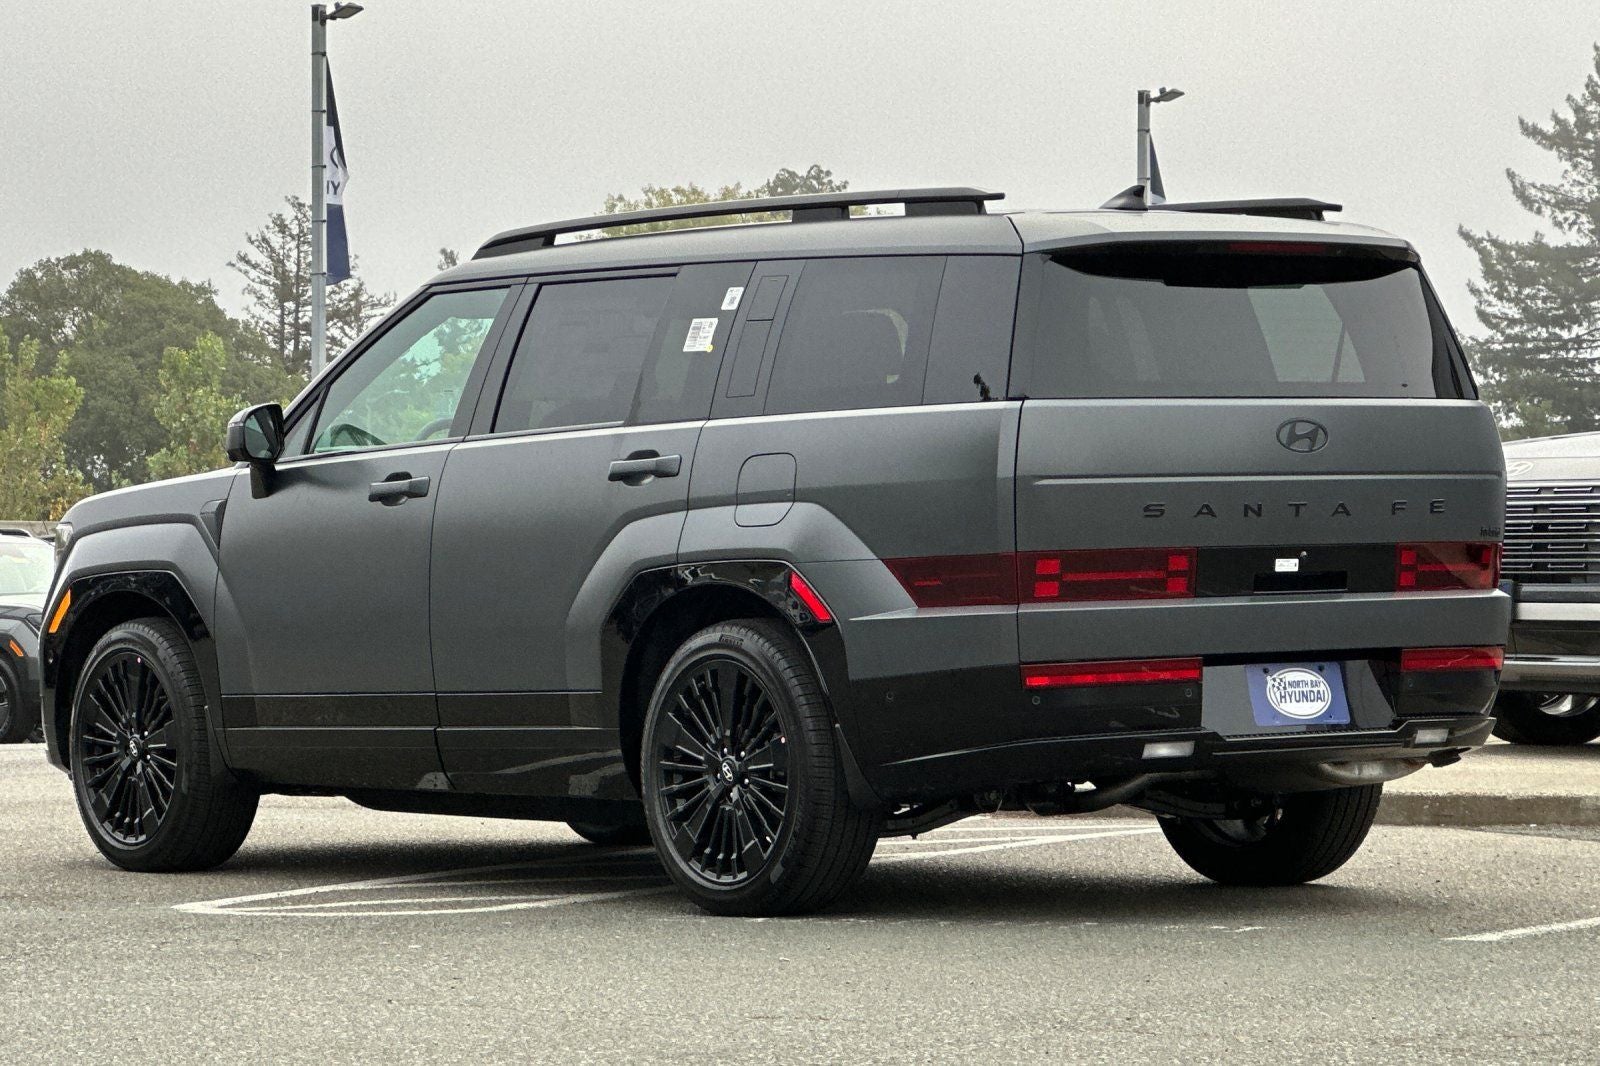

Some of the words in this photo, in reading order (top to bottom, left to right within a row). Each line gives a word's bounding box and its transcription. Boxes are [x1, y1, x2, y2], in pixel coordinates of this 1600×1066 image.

[1142, 501, 1352, 518] SANTA
[1391, 498, 1446, 515] FE
[1287, 679, 1309, 689] NORTH
[1310, 679, 1321, 688] BAY
[1279, 689, 1326, 704] HYUNDAI
